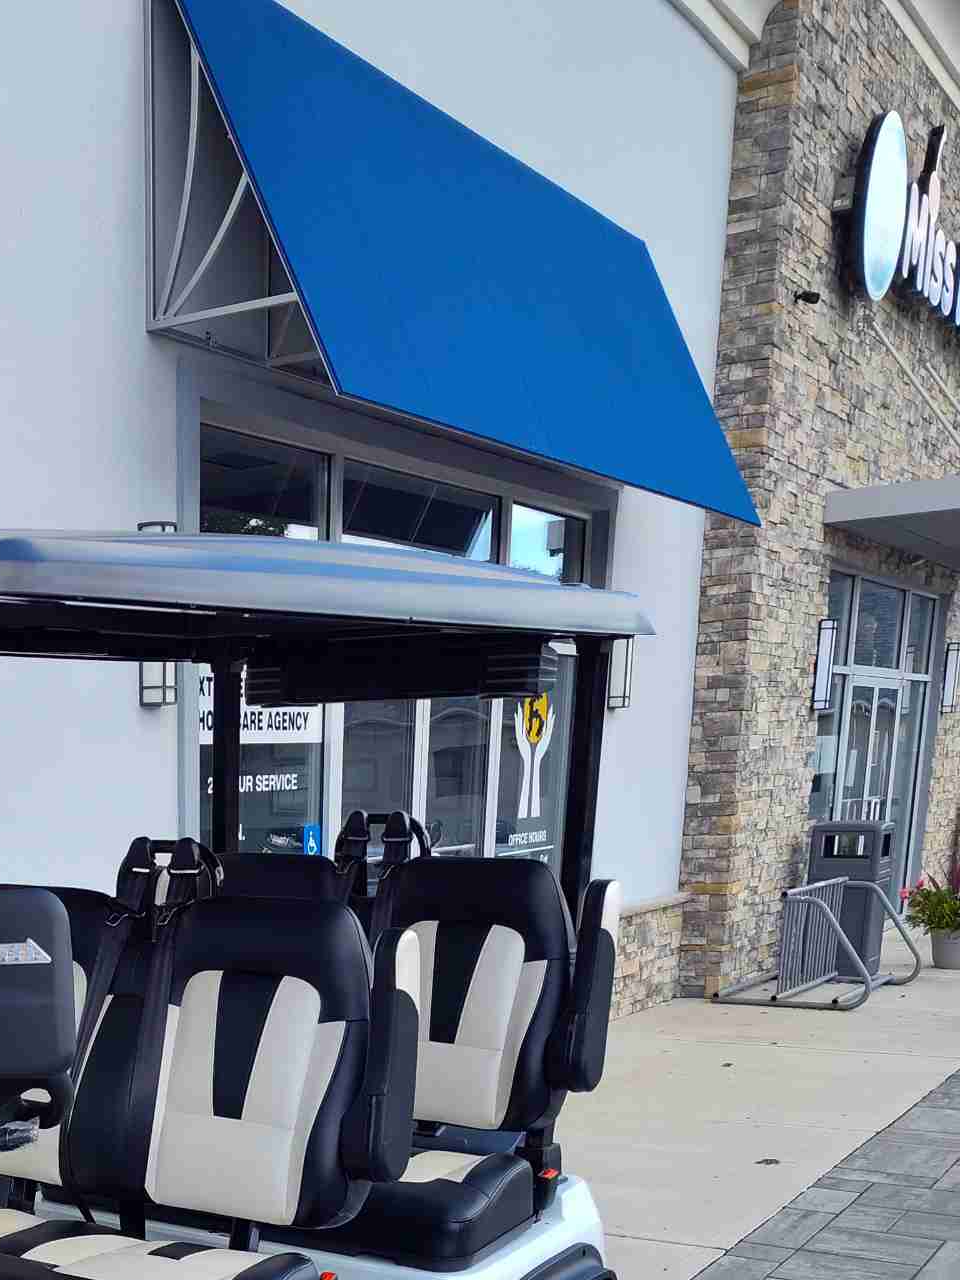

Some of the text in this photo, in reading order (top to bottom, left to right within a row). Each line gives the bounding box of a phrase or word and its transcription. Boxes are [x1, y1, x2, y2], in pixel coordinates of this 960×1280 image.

[240, 711, 263, 731] ARE
[267, 711, 309, 731] AGENCY
[239, 775, 253, 792] UR
[255, 774, 298, 792] SERVICE
[508, 833, 528, 846] OFFICE
